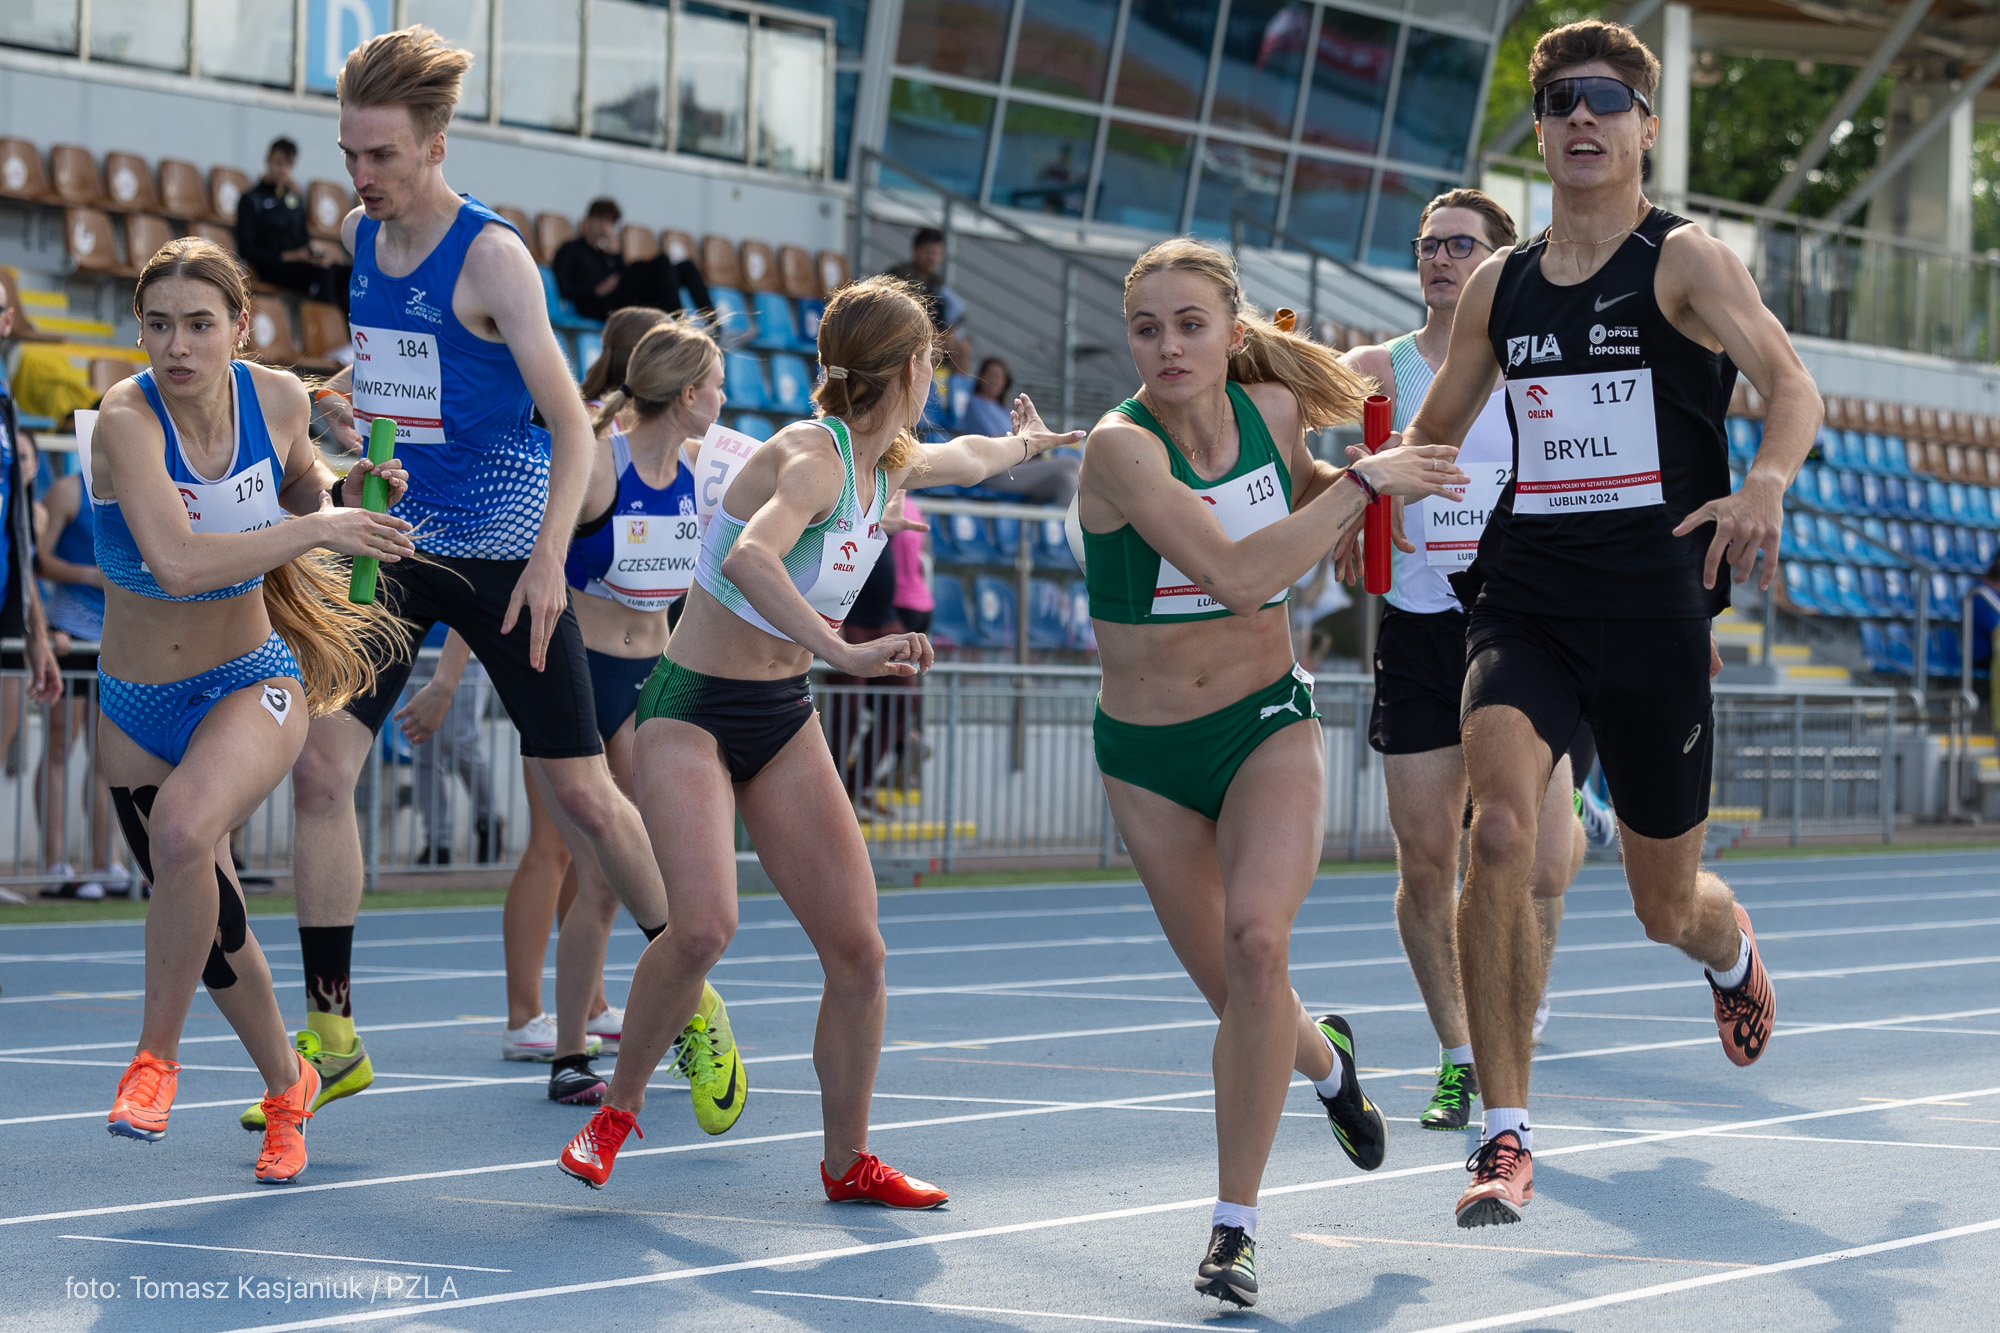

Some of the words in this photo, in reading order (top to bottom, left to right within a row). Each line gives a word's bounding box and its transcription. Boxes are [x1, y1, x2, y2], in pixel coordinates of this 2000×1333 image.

[1607, 330, 1639, 338] OPOLE
[397, 338, 428, 359] 184
[1594, 346, 1640, 355] OPOLSKIE
[357, 379, 437, 401] AWRZYNIAK
[1591, 379, 1637, 405] 117
[1527, 409, 1554, 419] ORLEN
[395, 428, 411, 437] 024
[1544, 436, 1617, 461] BRYLL
[1495, 468, 1514, 485] 2
[1586, 479, 1621, 488] SZTAFETACH
[1621, 474, 1657, 485] MIESZANYCH
[235, 472, 264, 504] 176
[1246, 475, 1274, 506] 113
[1549, 496, 1587, 507] LUBLIN
[1589, 493, 1619, 504] 2024
[1433, 509, 1494, 526] MICHA
[675, 521, 702, 540] 30
[833, 562, 856, 573] ORLEN
[627, 598, 654, 607] LUBLIN
[1197, 598, 1219, 607] LUB
